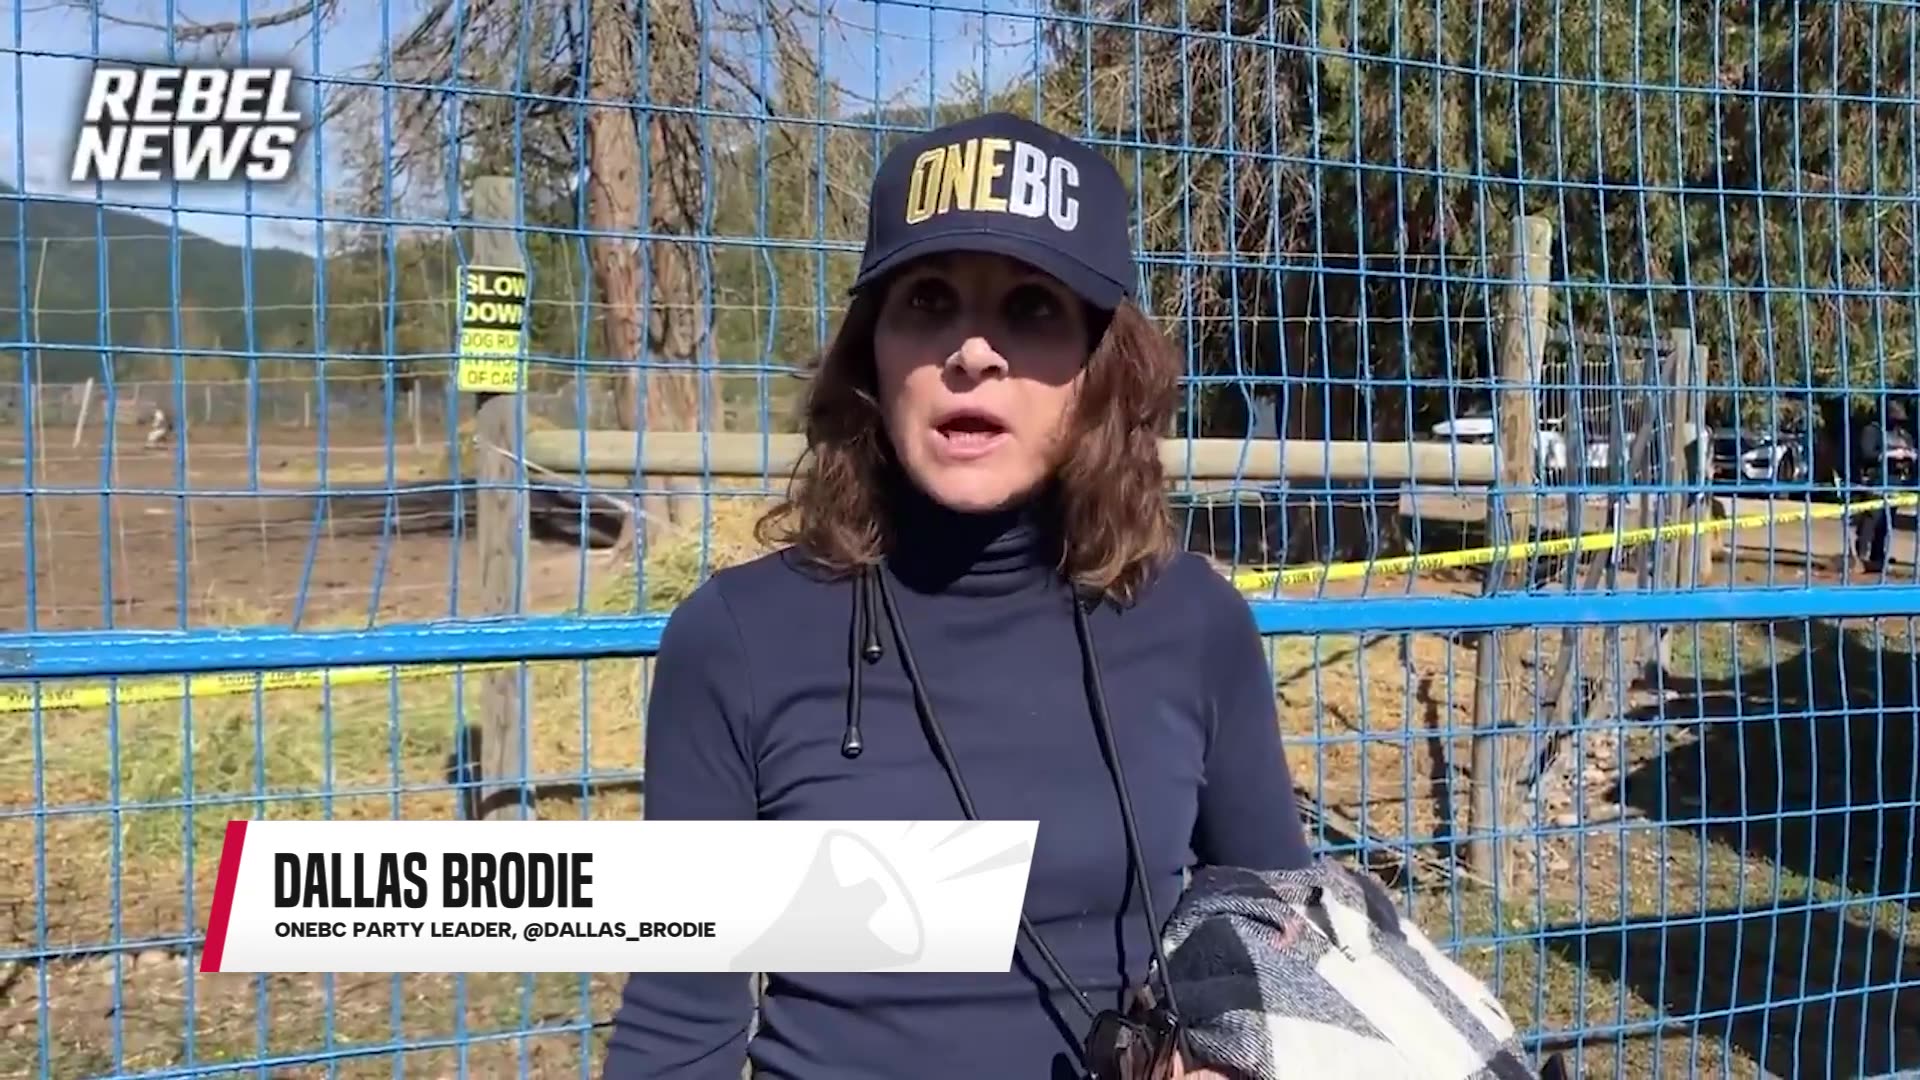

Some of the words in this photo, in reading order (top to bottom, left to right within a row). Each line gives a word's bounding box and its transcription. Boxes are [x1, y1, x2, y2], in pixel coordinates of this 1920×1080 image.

[906, 137, 1080, 232] ONEBC
[466, 273, 526, 297] SLOW
[497, 333, 519, 349] RU
[467, 370, 488, 385] OF
